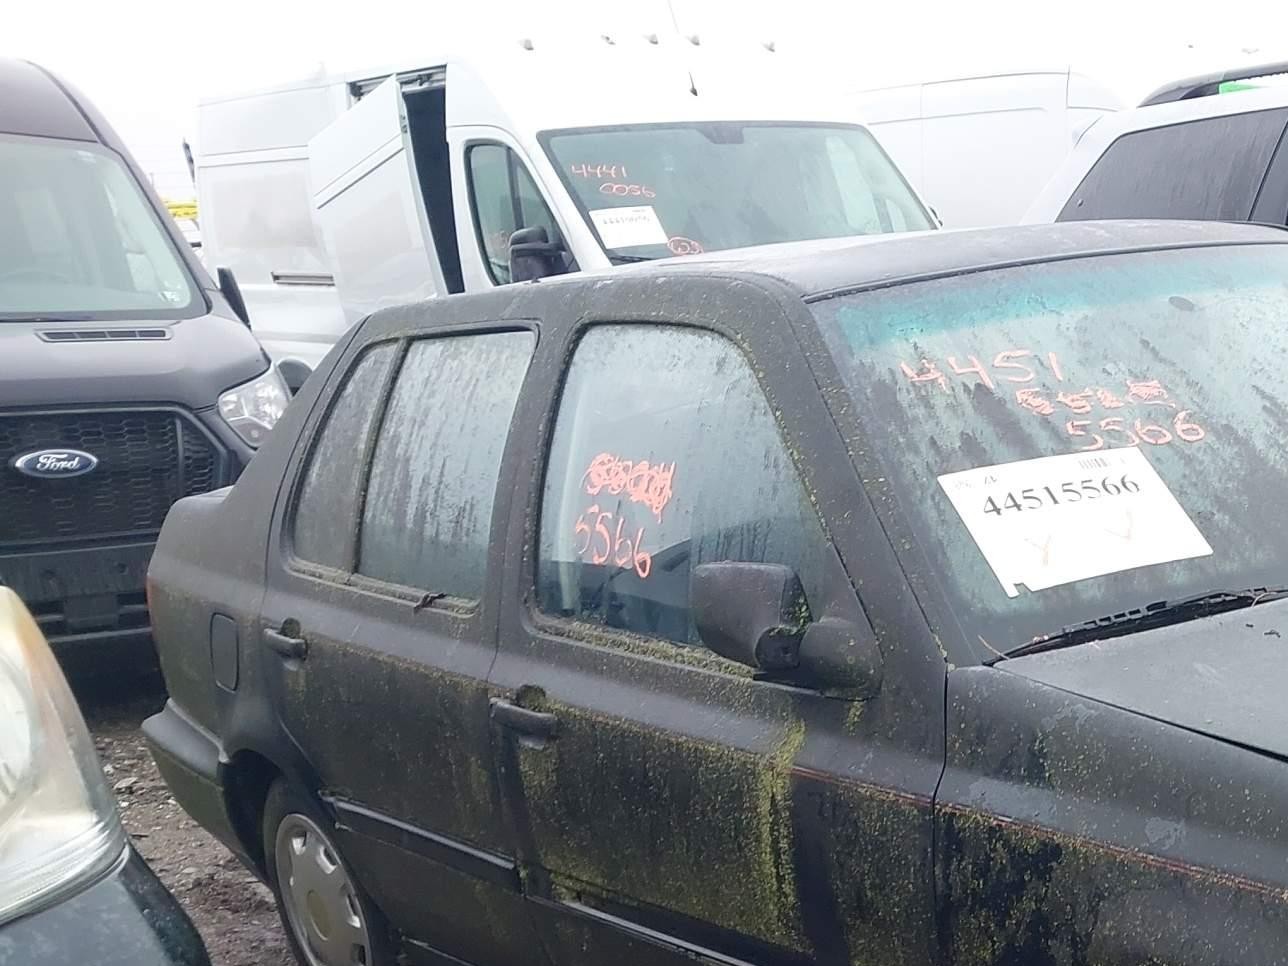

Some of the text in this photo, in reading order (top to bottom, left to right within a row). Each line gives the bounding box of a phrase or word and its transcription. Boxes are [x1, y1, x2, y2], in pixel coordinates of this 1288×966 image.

[571, 164, 628, 178] 4441
[901, 351, 1062, 391] 4451
[1065, 410, 1205, 450] 5566
[36, 453, 81, 471] Ford
[983, 474, 1140, 516] 44515566
[576, 505, 651, 578] 5566
